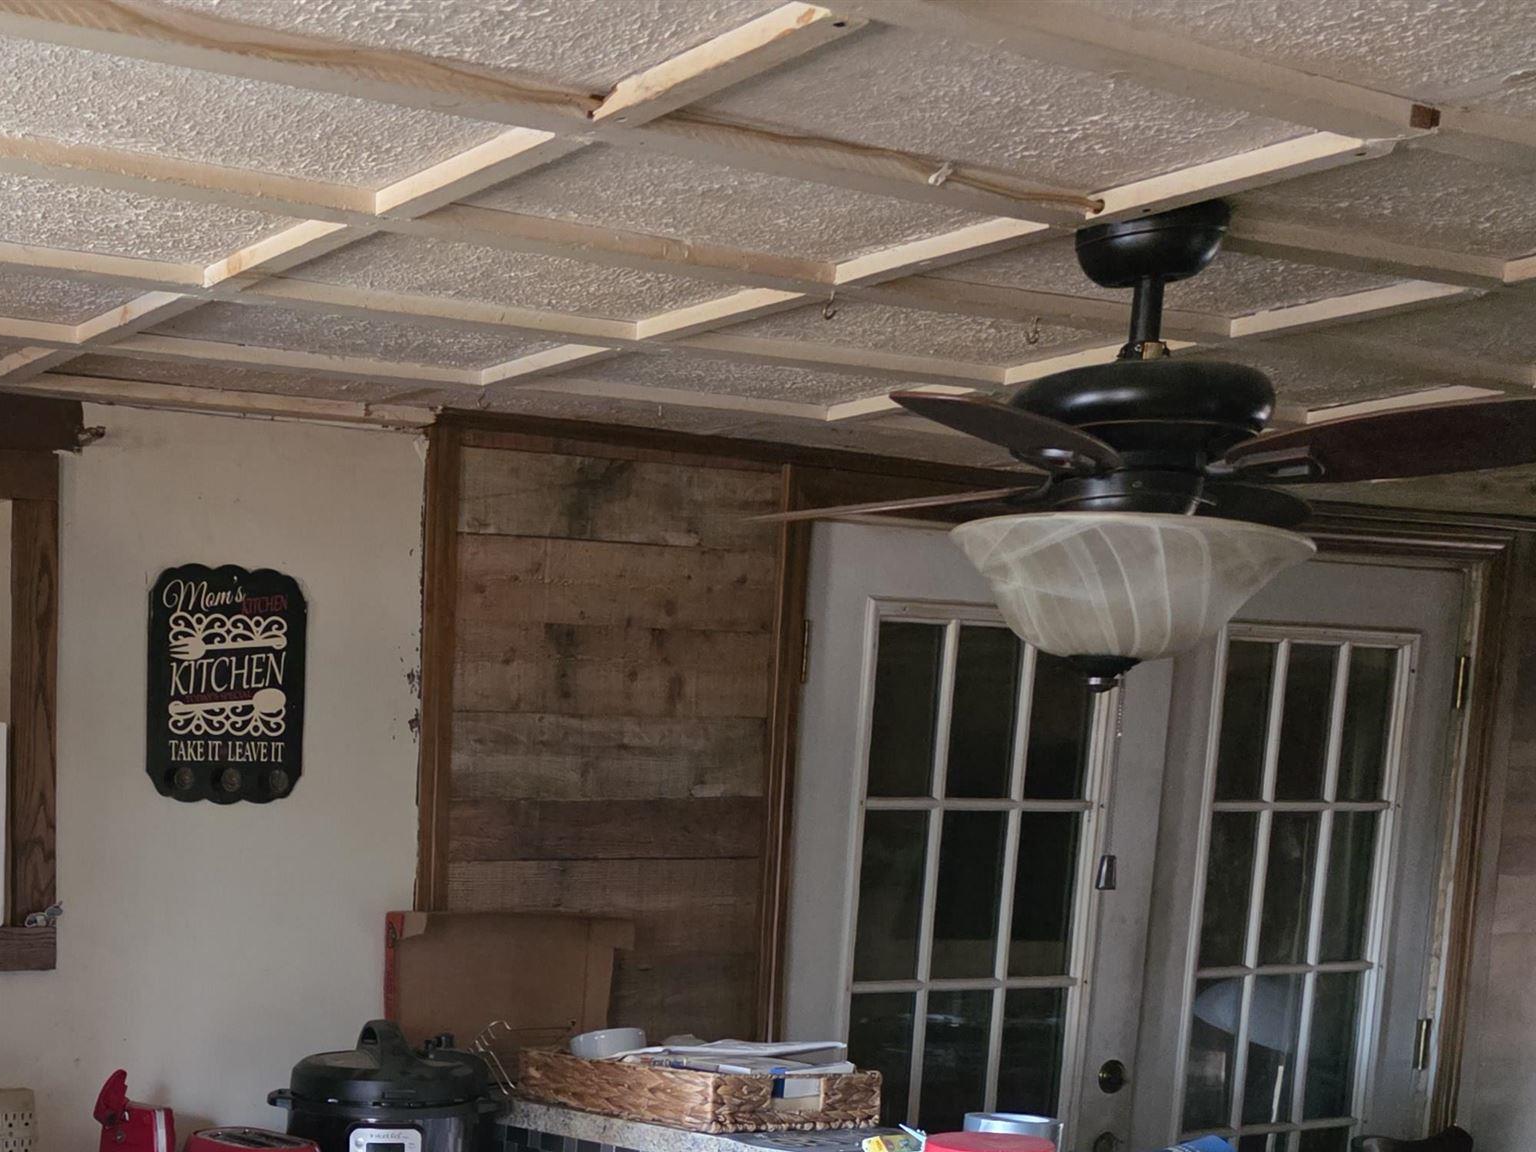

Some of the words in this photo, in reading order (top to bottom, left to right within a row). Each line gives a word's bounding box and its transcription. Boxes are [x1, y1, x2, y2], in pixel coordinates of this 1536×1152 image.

[163, 575, 246, 612] Mom's
[169, 651, 286, 697] KITCHEN
[169, 740, 204, 761] TAKE
[208, 740, 222, 761] IT
[228, 740, 269, 762] LEAVE
[271, 741, 285, 762] IT
